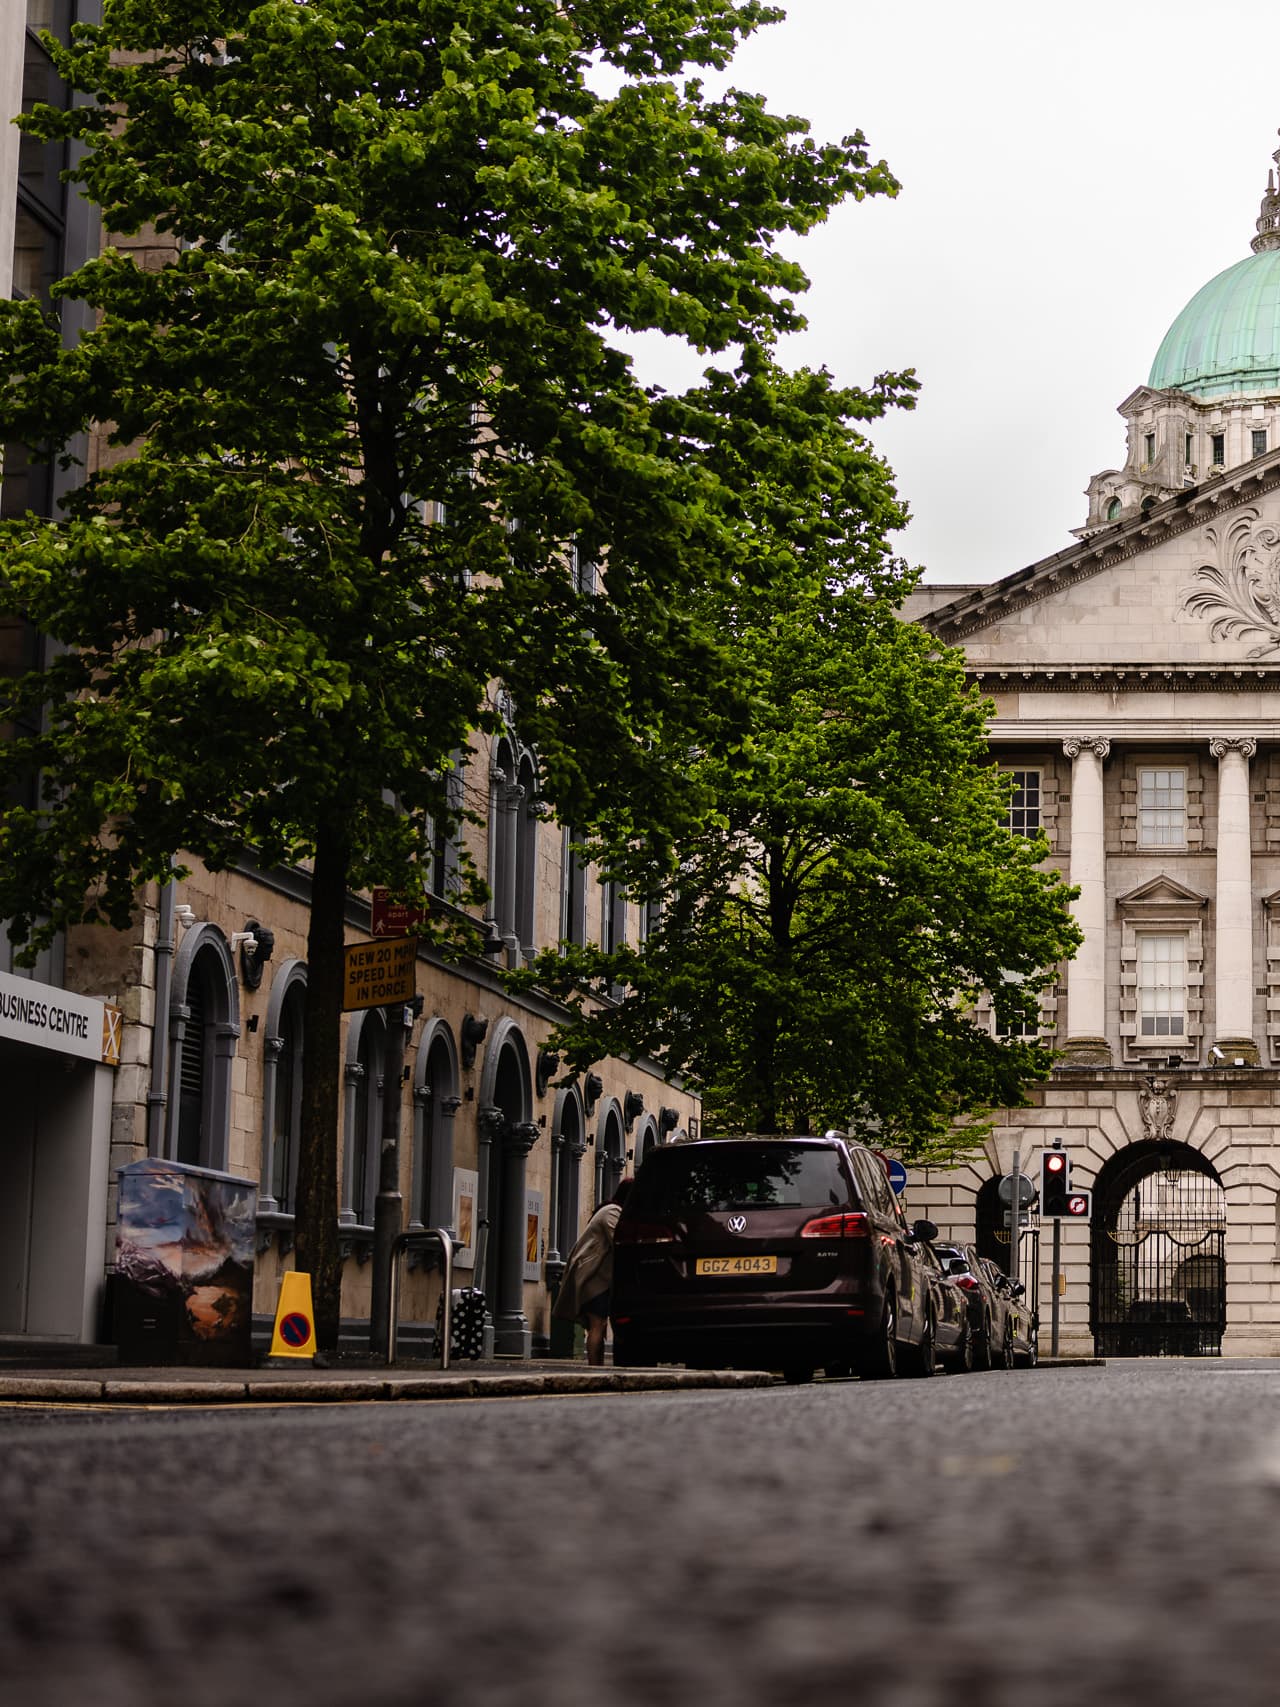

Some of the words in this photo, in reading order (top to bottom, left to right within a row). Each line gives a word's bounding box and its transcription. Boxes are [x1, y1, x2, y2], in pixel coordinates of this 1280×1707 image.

[349, 951, 375, 967] NEW
[377, 948, 391, 963] 20
[349, 967, 385, 985] SPEED
[356, 986, 369, 1001] IN
[372, 980, 406, 998] FORCE
[49, 1007, 88, 1039] CENTRE
[103, 1009, 122, 1059] X
[702, 1260, 730, 1273] GGZ
[734, 1258, 770, 1272] 4043
